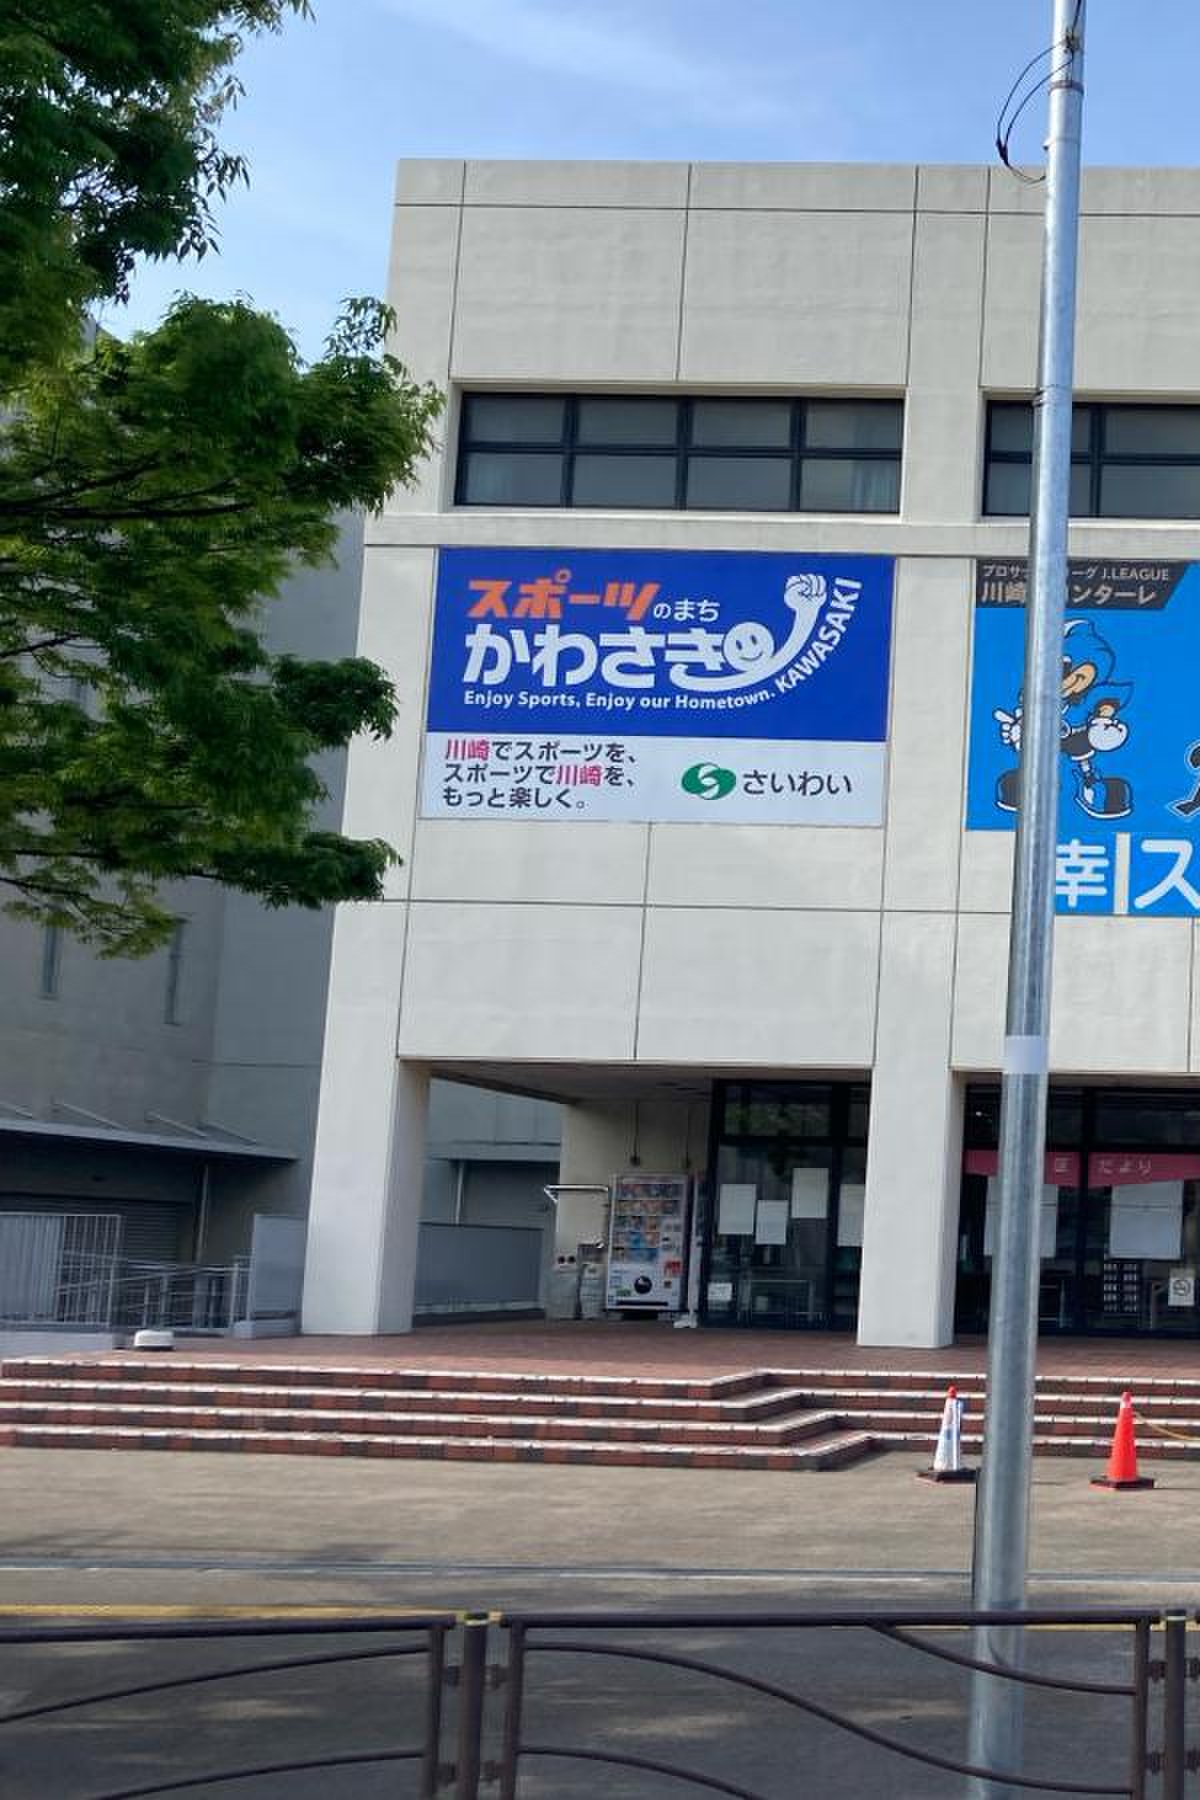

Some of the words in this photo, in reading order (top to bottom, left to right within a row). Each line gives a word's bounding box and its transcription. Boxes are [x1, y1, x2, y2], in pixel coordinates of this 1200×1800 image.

[1101, 567, 1169, 581] J.LEAGUE
[467, 568, 721, 623] スポーツのまち
[982, 582, 1157, 604] 川崎ンターレ
[464, 690, 514, 709] Enjoy
[585, 692, 636, 712] Enjoy
[640, 696, 670, 710] our
[675, 691, 776, 711] Hometown.
[775, 576, 864, 694] KAWASAKI
[462, 622, 778, 693] かわさき
[444, 739, 639, 764] 川崎でスポーツを、
[443, 763, 637, 788] スポーツで川崎を、
[743, 769, 852, 796] さいわい
[443, 787, 588, 809] もっと楽しく。
